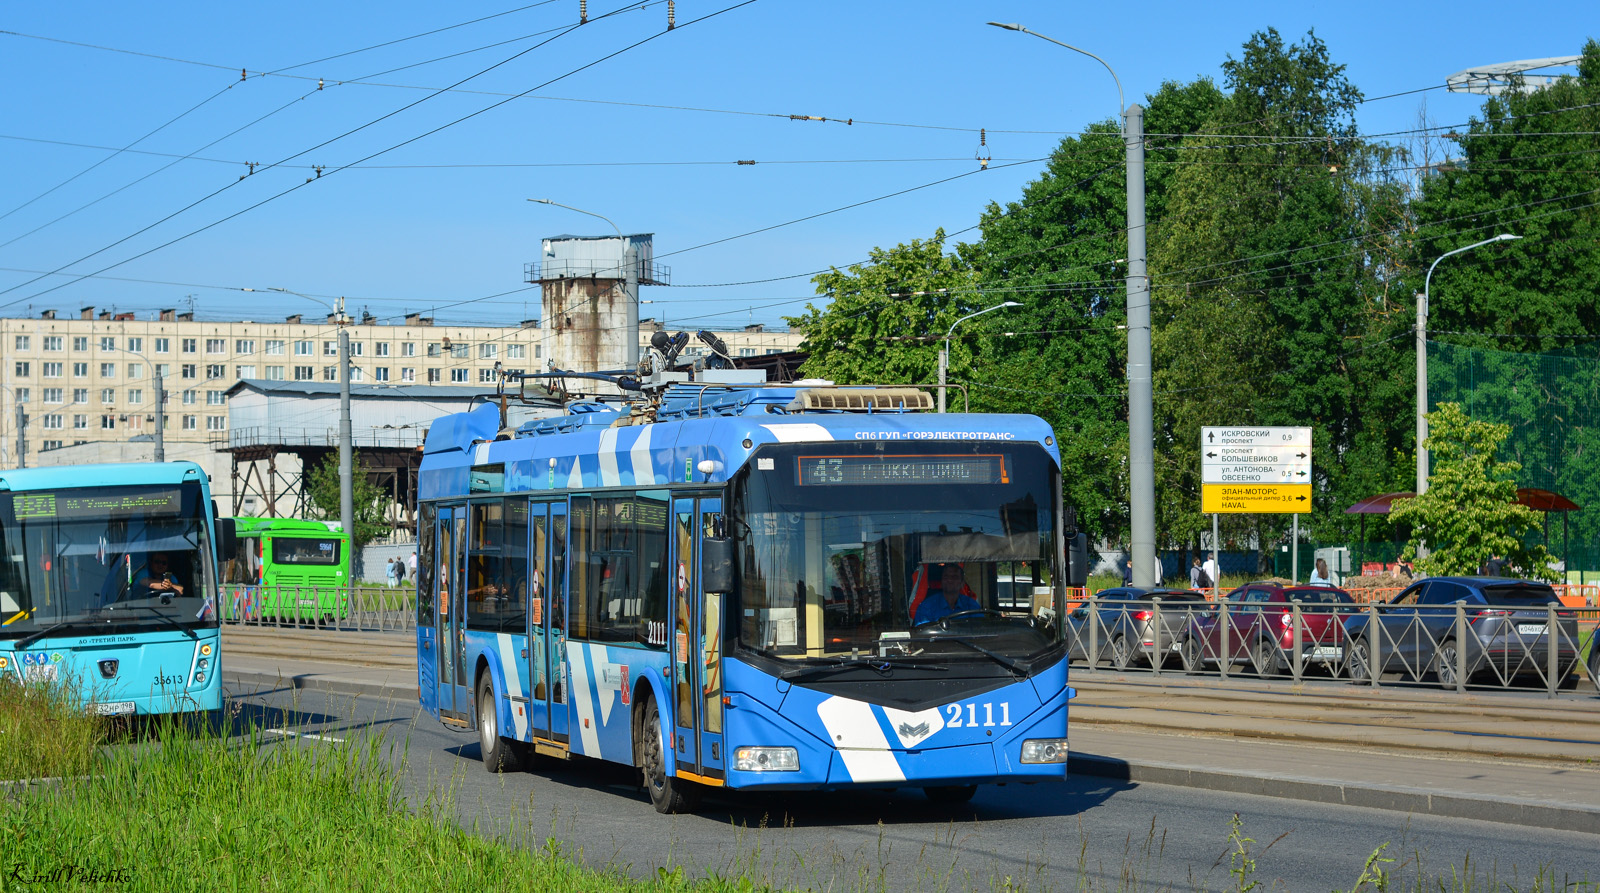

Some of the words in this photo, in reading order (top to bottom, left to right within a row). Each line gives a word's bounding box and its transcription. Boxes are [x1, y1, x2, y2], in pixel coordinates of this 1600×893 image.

[854, 431, 877, 440] СПб
[878, 431, 900, 440] ГУП
[902, 431, 1015, 440] «ГОРЭЛЕКТРОТРАНС»
[813, 458, 843, 482] 43
[648, 620, 665, 645] 2111
[153, 675, 184, 686] 35613
[946, 702, 1012, 728] 2111
